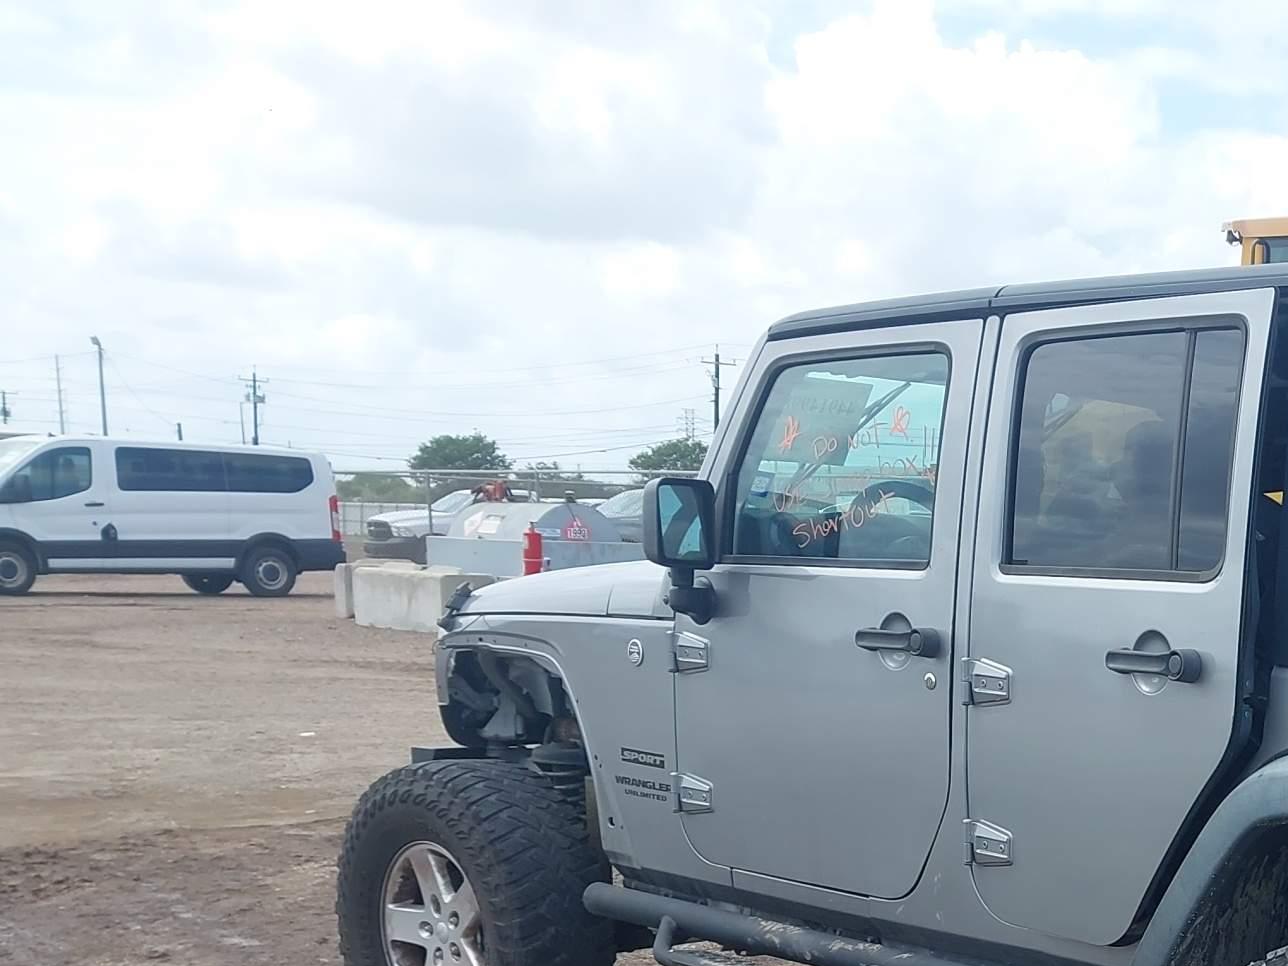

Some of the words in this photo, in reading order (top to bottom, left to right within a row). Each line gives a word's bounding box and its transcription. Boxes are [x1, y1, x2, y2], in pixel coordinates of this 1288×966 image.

[621, 748, 664, 768] SPORT
[615, 775, 672, 793] WRANGLER
[624, 788, 667, 802] UNLIMITED
